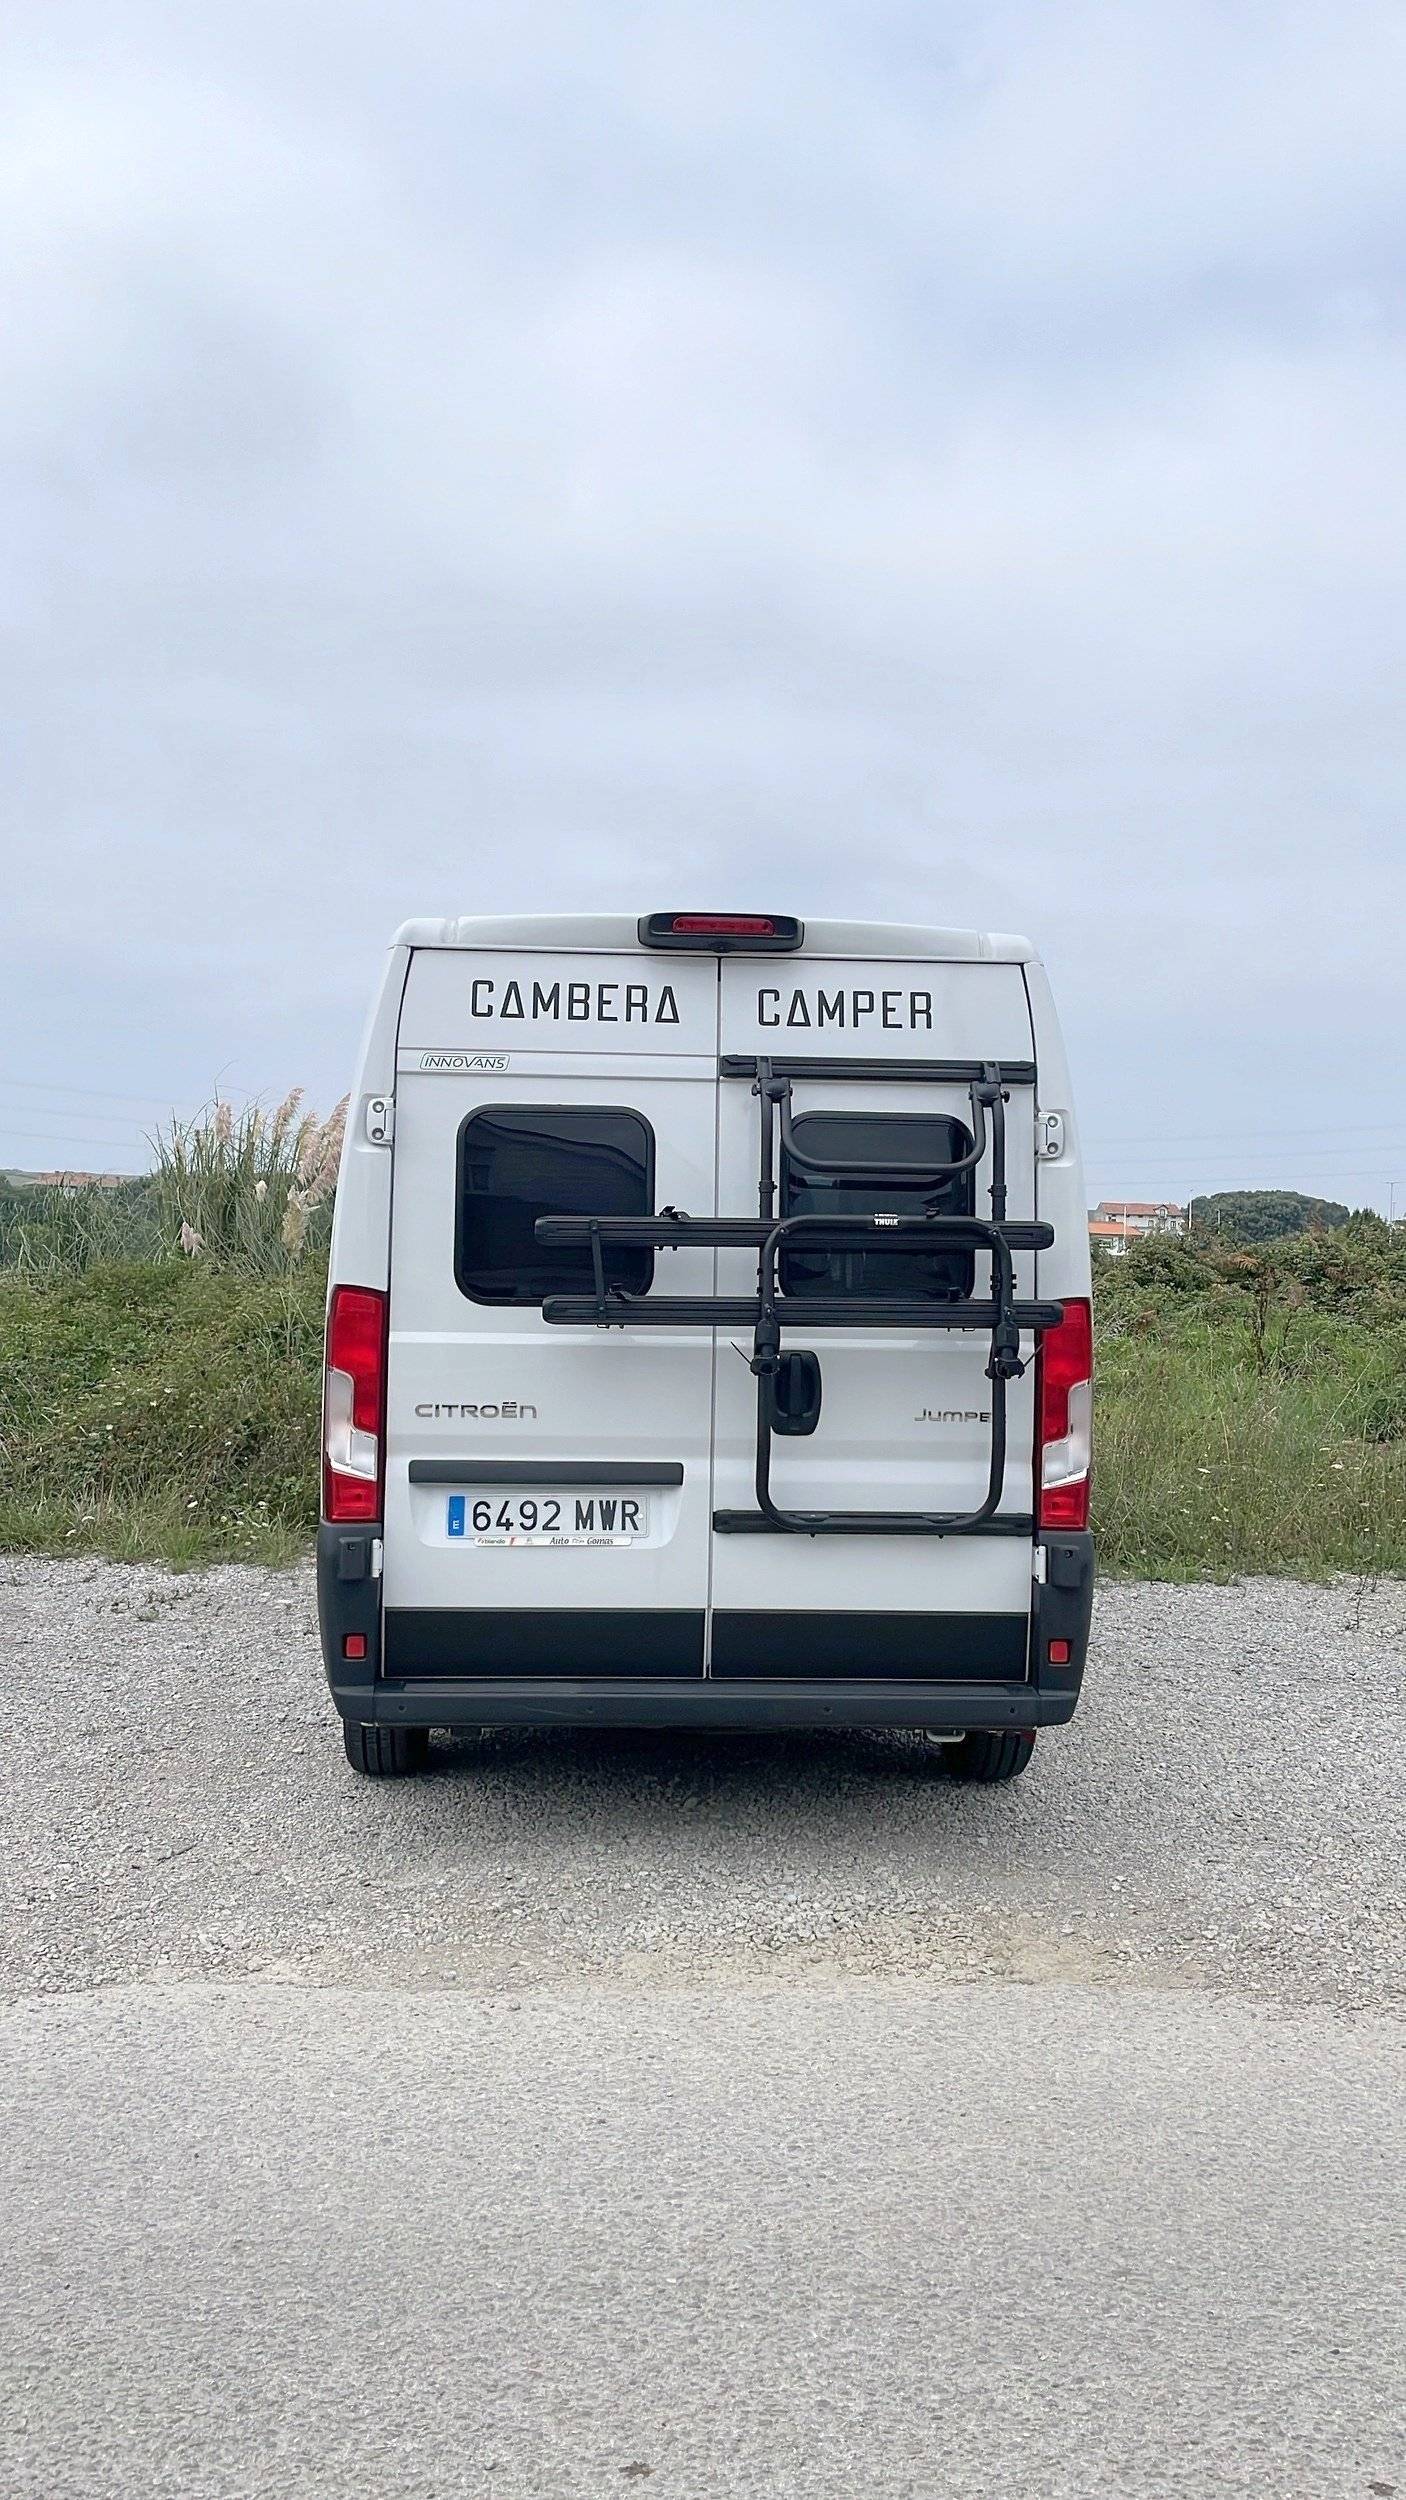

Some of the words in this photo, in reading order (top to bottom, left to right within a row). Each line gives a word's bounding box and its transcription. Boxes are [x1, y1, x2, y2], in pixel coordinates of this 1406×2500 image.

[471, 979, 680, 1024] CAMBERA
[758, 988, 932, 1029] CAMPER
[424, 1055, 507, 1069] INNOVANS
[472, 1499, 561, 1532] 6492
[575, 1499, 640, 1531] MWR
[452, 1520, 460, 1530] E
[549, 1536, 570, 1545] Auto
